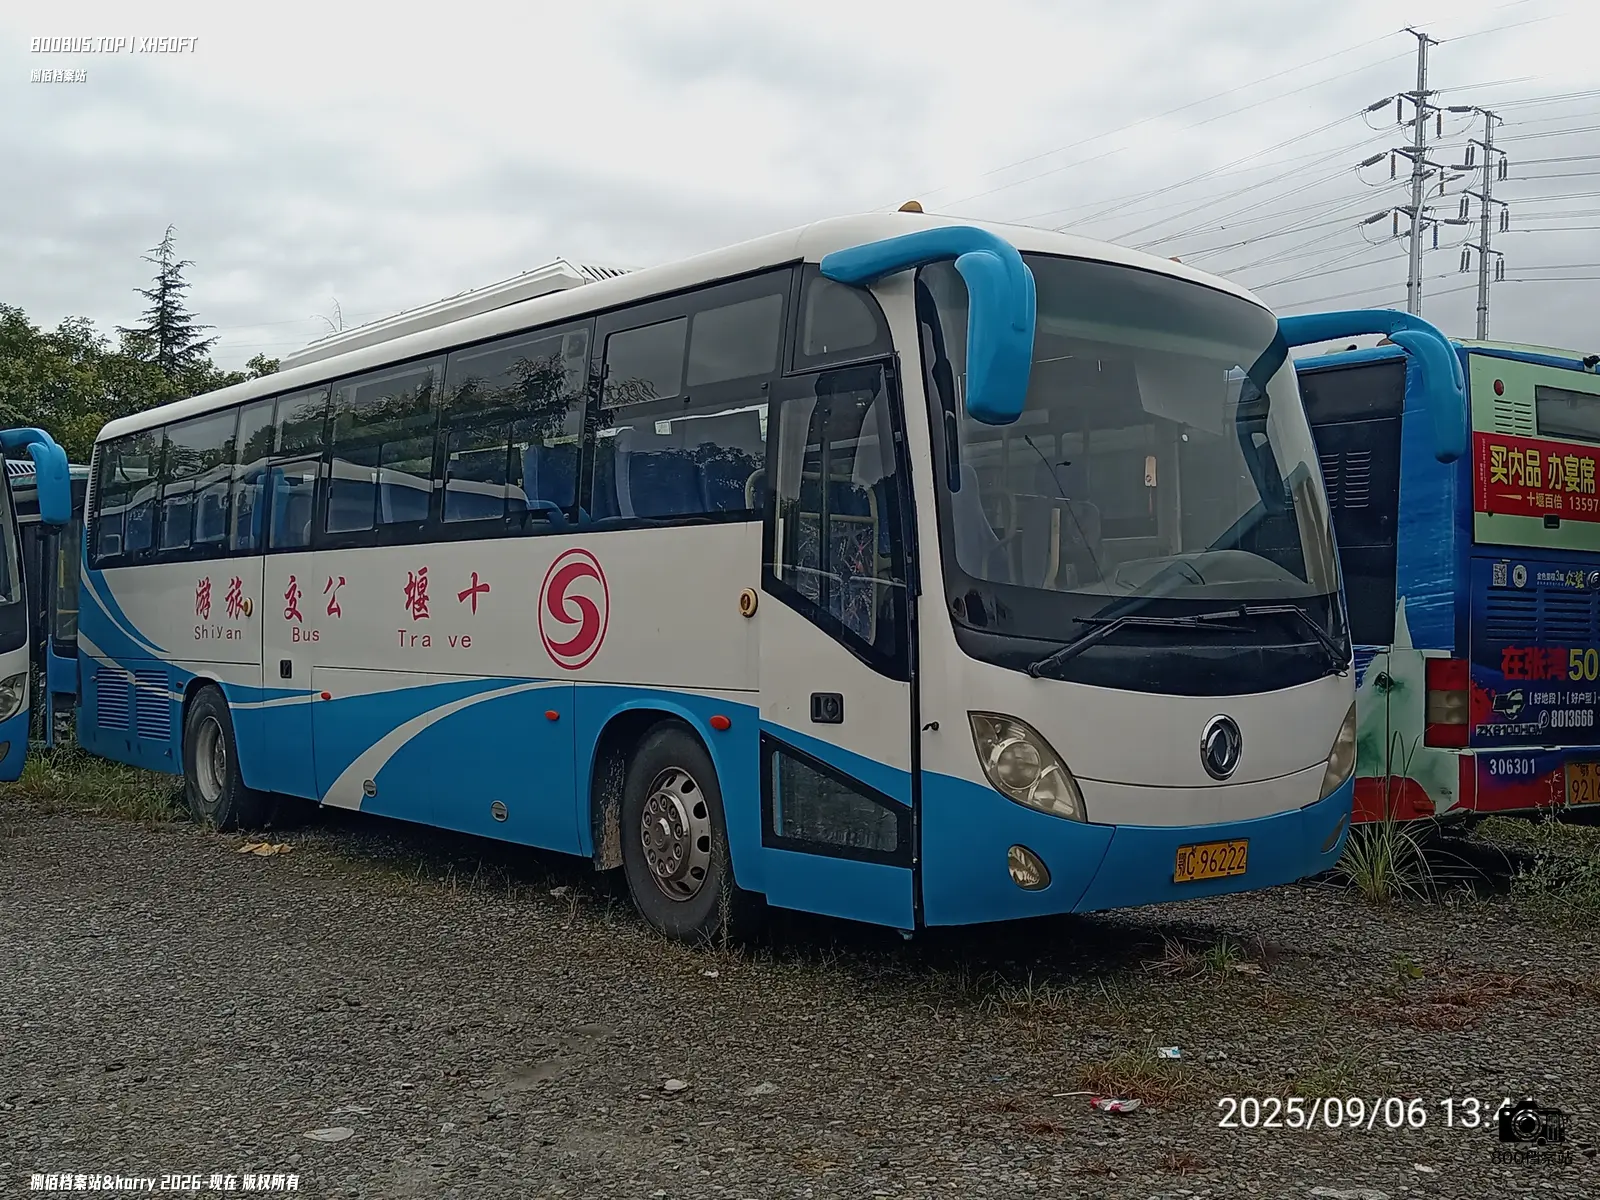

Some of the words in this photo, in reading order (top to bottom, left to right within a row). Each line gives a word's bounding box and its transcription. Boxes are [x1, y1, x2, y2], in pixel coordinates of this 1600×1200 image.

[1548, 452, 1596, 494] 办宴席
[194, 624, 242, 640] ShiYan
[292, 626, 320, 643] Bus
[1550, 709, 1594, 728] 8013666
[1489, 758, 1536, 775] 306301
